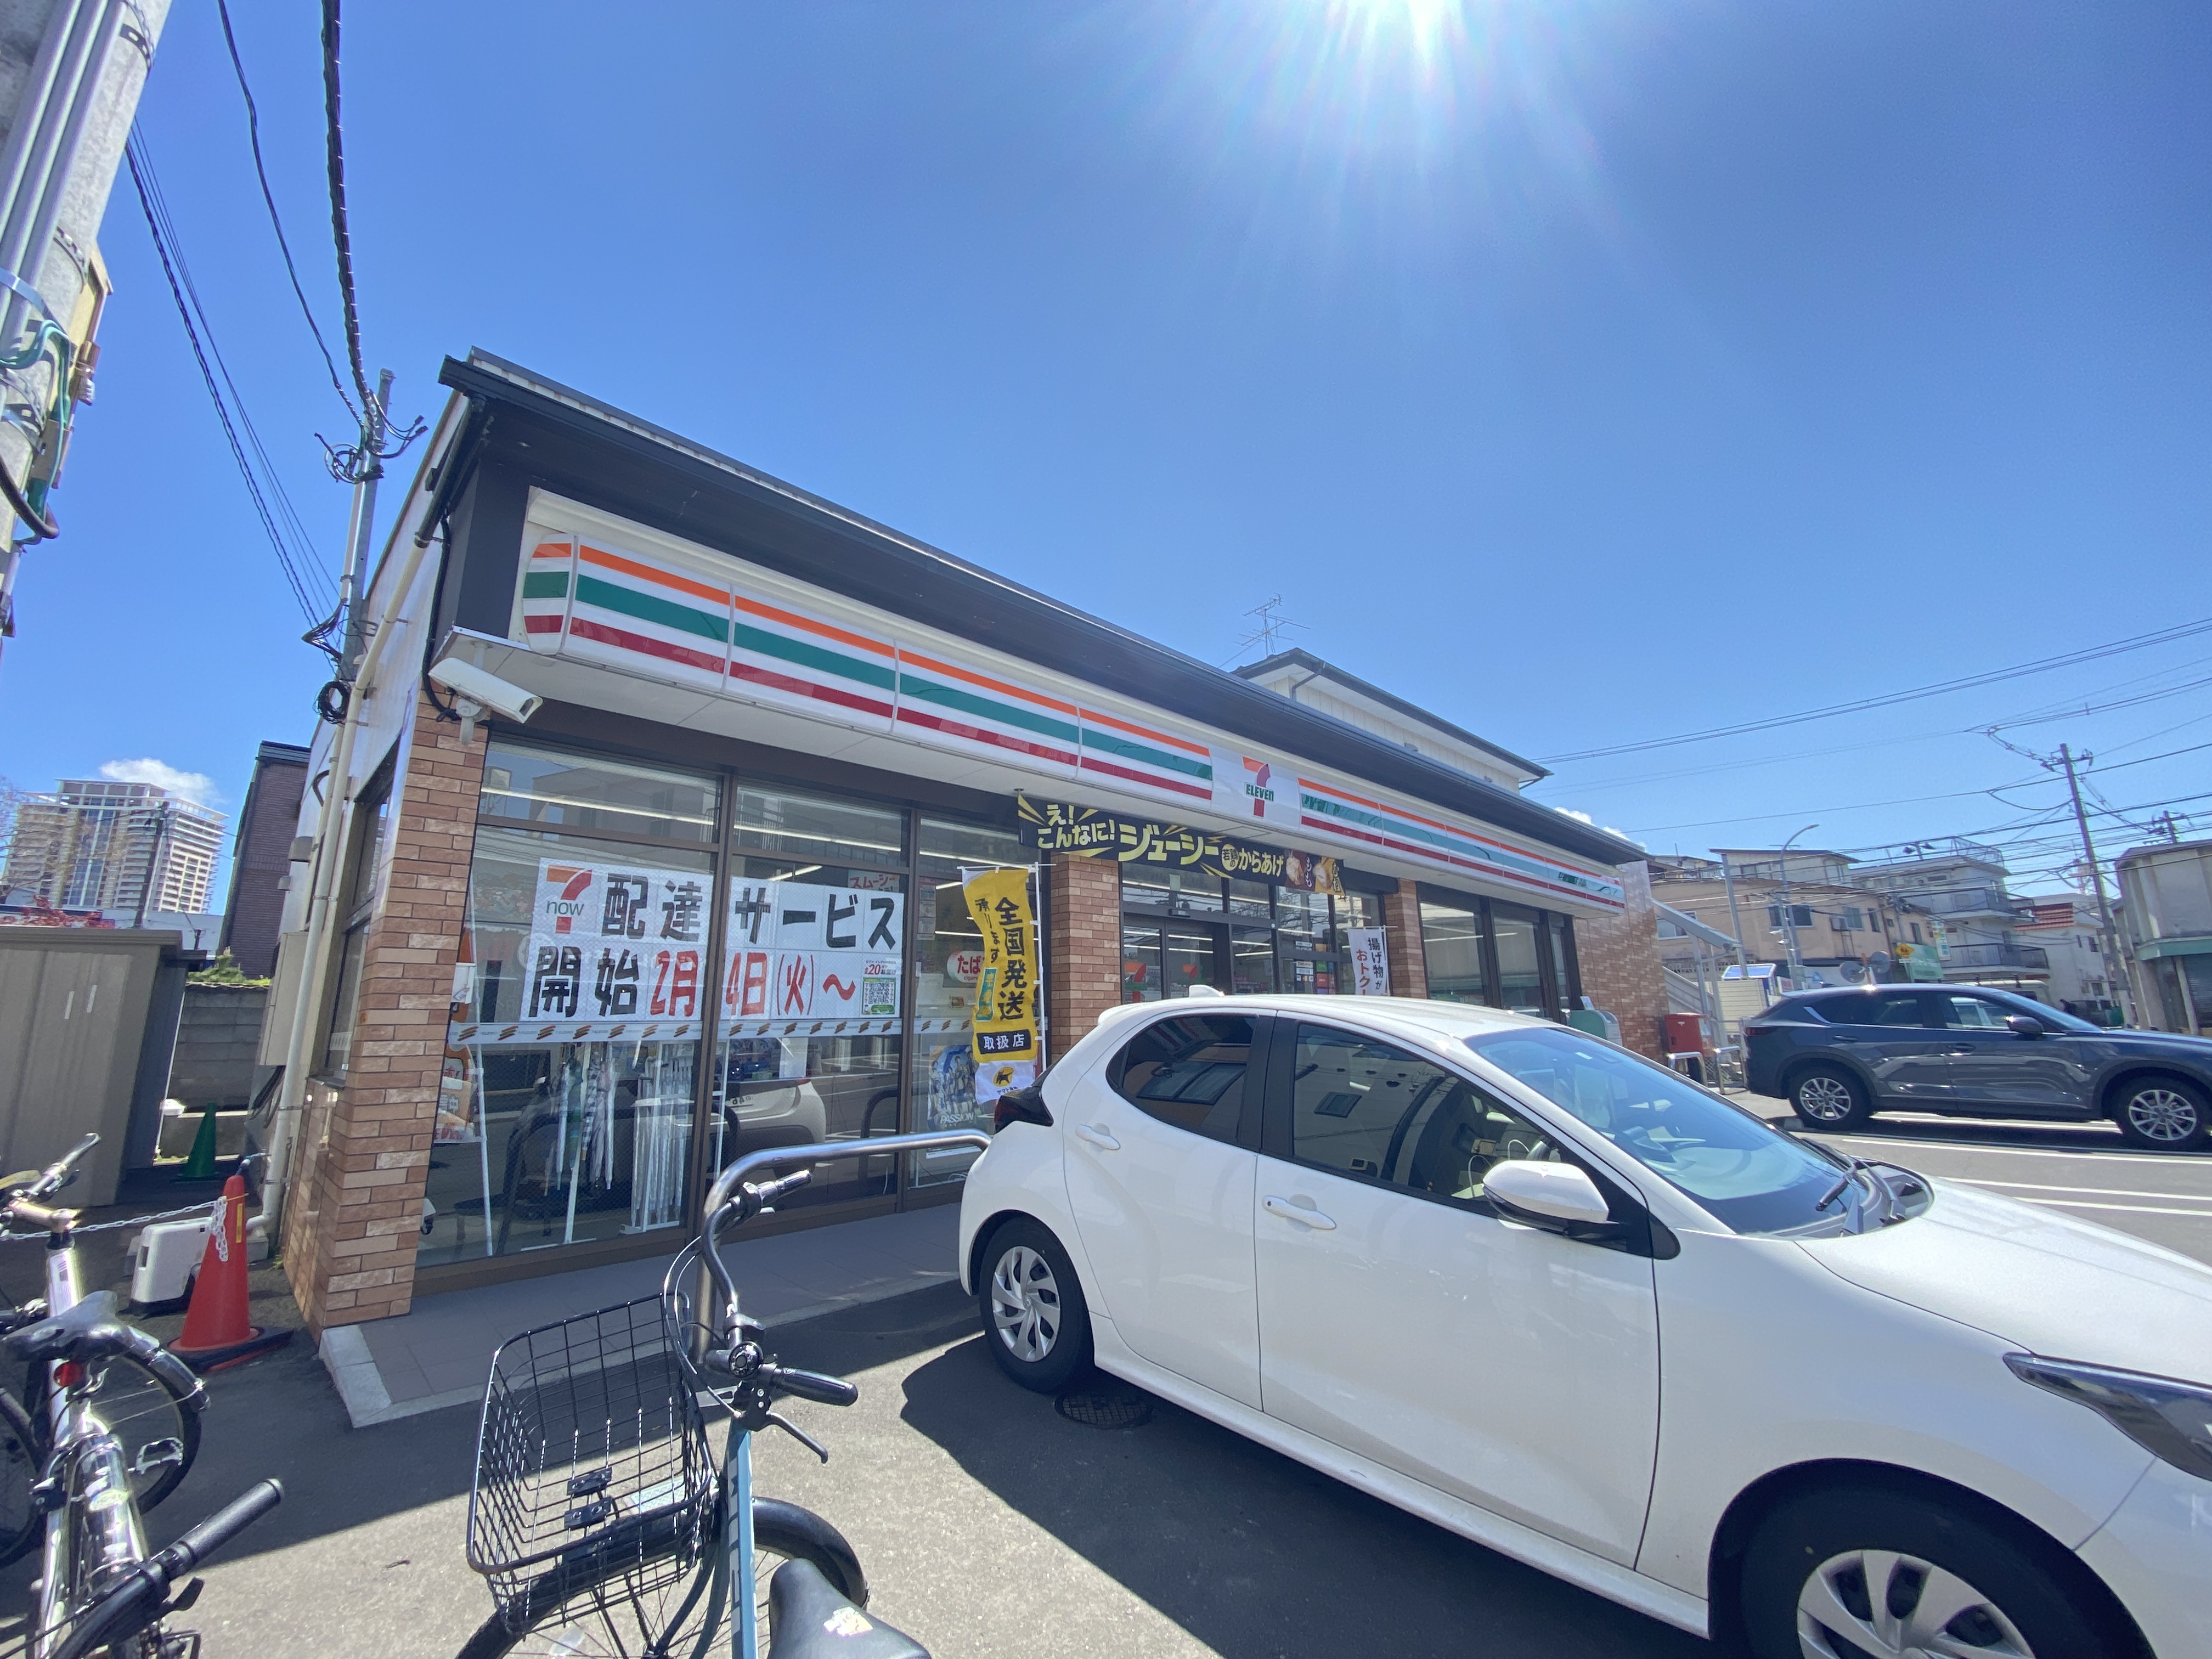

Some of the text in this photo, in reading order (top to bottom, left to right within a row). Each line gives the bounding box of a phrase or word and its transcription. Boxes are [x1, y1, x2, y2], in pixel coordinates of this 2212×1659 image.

[1037, 819, 1115, 849] こんなに!
[1118, 824, 1219, 865] ジューシー
[1238, 848, 1284, 877] からあげ
[546, 900, 584, 916] now
[957, 955, 984, 974] たば
[995, 897, 1027, 1020] 全国発送
[1367, 938, 1384, 990] 揚げ物が
[984, 1033, 1025, 1049] 取扱店
[940, 1112, 974, 1124] PASSION
